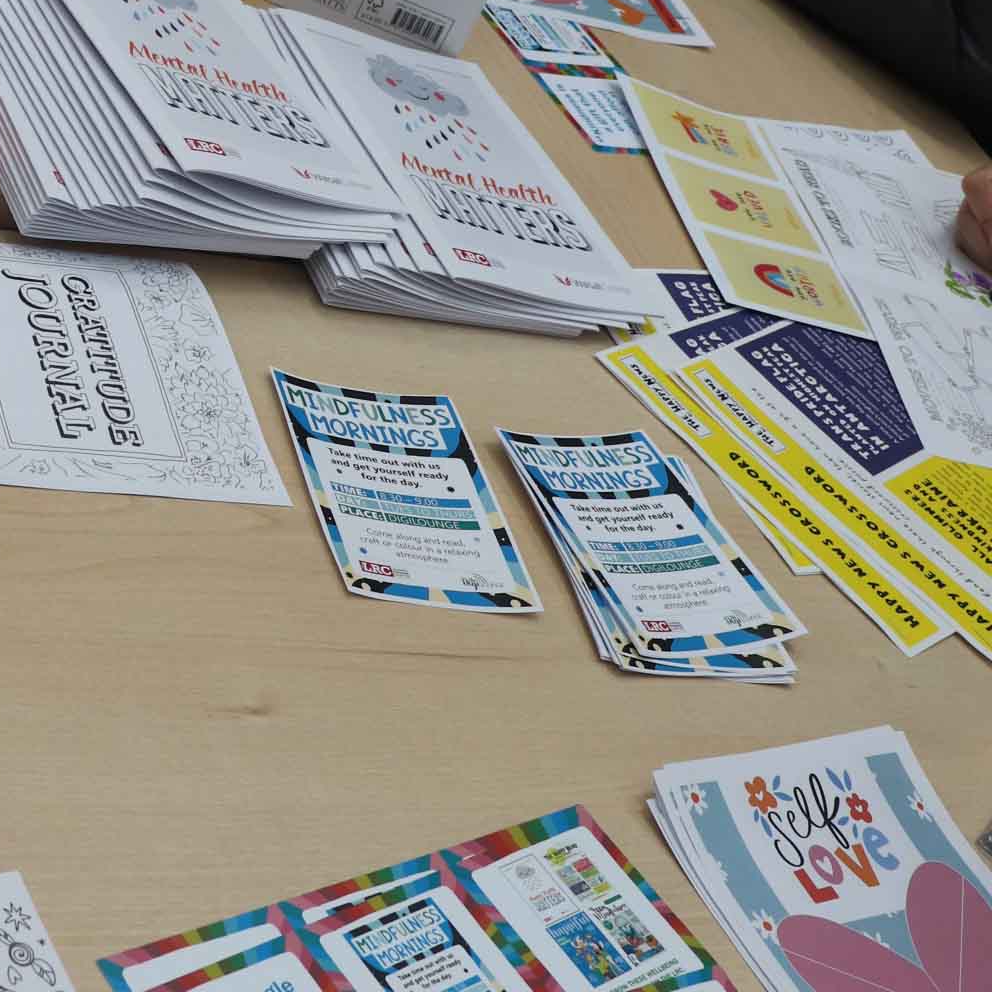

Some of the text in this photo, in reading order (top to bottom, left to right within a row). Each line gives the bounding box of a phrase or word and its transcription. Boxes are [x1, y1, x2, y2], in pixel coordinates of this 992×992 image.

[129, 41, 288, 102] Mental Health
[138, 63, 330, 148] MATTERS
[401, 152, 553, 205] Mental Health
[410, 174, 593, 252] MATTERS
[2, 268, 97, 441] JOURNAL
[59, 275, 144, 448] GRATITUDE
[287, 386, 451, 426] MINDFULNESS
[627, 361, 703, 433] THE HAPPY NEWS
[748, 348, 872, 460] TRANS PRIDE FLAG
[766, 340, 872, 434] ANTARCTICA
[311, 414, 439, 447] MORNINGS
[701, 375, 777, 448] THE HAPPY NEWS
[329, 448, 351, 458] Take
[353, 452, 378, 463] time
[381, 458, 399, 466] out
[401, 460, 426, 470] with
[517, 445, 653, 469] MINDFULNESS
[869, 432, 891, 451] IN
[331, 459, 449, 481] and get yourself ready
[333, 483, 368, 497] TIME:
[361, 473, 378, 482] for
[380, 475, 397, 485] the
[544, 468, 652, 490] MORNINGS
[725, 446, 824, 541] CROSSWORD
[341, 506, 461, 529] PLACE: DIGILOUNGE
[805, 466, 898, 549] CROSSWORD
[921, 478, 988, 535] UKRAINE
[361, 563, 392, 575] LRC
[643, 559, 702, 573] DIGILOUNGE
[819, 534, 868, 581] NEWS
[900, 551, 946, 589] NEWS
[865, 576, 921, 630] HAPPY
[645, 622, 670, 632] LRC
[357, 908, 442, 955] MINDFULNESS
[377, 930, 446, 968] MORNINGS
